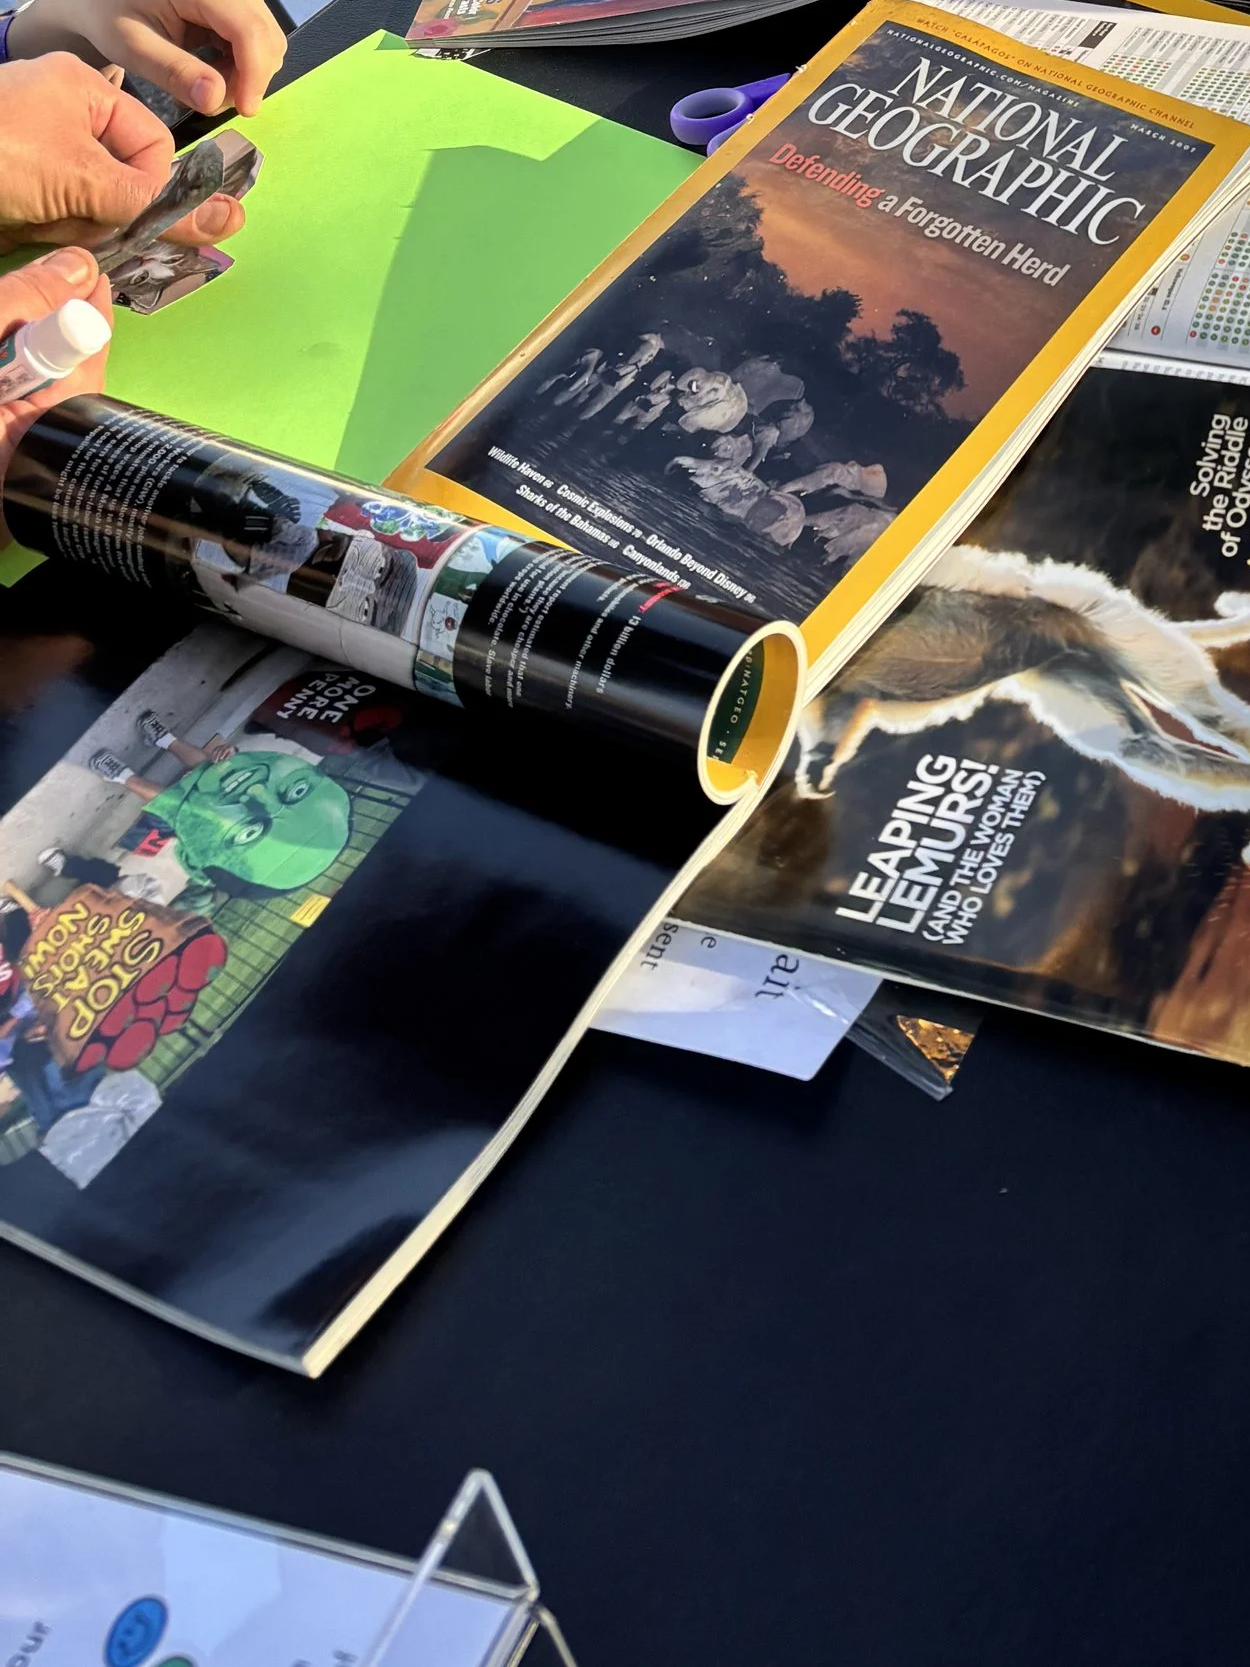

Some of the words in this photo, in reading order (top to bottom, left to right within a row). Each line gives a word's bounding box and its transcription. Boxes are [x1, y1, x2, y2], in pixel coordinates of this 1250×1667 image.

[886, 28, 1081, 108] NATIONALGEOGRAPHIC.COM/MAGAZINE
[915, 18, 951, 34] WATCH
[1016, 56, 1032, 69] ON
[1033, 63, 1083, 88] NATIONAL
[1085, 83, 1148, 113] GEOGRAPHIC
[1148, 106, 1196, 131] CHANNEL
[888, 57, 1129, 183] NATIONAL
[1130, 122, 1166, 142] MARCH
[808, 83, 1146, 246] GEOGRAPHIC
[769, 143, 886, 210] Defending
[877, 192, 900, 212] a
[895, 195, 1007, 259] Forgotten
[1001, 242, 1072, 287] Herd
[71, 422, 105, 461] suppliers
[82, 446, 96, 462] for
[106, 427, 148, 465] awareness
[123, 438, 159, 478] estimates
[150, 444, 183, 478] Workers
[1190, 414, 1232, 498] Solving
[1213, 416, 1249, 489] Riddle
[73, 460, 86, 478] the
[99, 463, 110, 476] of
[106, 451, 132, 484] wages.
[112, 476, 129, 498] that
[155, 462, 179, 490] tackle
[138, 488, 161, 526] another
[487, 446, 521, 471] Wildlife
[516, 461, 546, 487] Haven
[556, 483, 590, 511] Cosmic
[587, 500, 636, 536] Explosions
[645, 533, 684, 561] Orlando
[679, 550, 722, 584] Beyond
[713, 571, 748, 603] Disney
[1202, 492, 1230, 532] the
[515, 484, 547, 511] Sharks
[544, 500, 558, 514] of
[555, 505, 573, 522] the
[569, 513, 612, 545] Bahamas
[622, 543, 680, 584] Canyonlands
[1221, 532, 1241, 558] of
[513, 560, 535, 583] crops
[516, 577, 530, 593] use
[528, 567, 542, 581] for
[485, 579, 517, 627] worldwide.
[510, 591, 520, 602] in
[527, 594, 545, 616] they
[540, 587, 563, 616] report
[488, 600, 514, 649] chocolate.
[519, 613, 545, 660] estimated
[589, 616, 604, 635] and
[608, 624, 634, 657] billion
[483, 649, 496, 674] Slave
[507, 631, 526, 669] cheaper
[577, 632, 594, 660] other
[504, 669, 513, 687] and
[516, 659, 526, 680] that
[563, 659, 581, 710] machinery.
[594, 656, 616, 694] dollars
[275, 671, 340, 722] PENNY
[296, 676, 361, 722] MORE
[319, 682, 378, 724] ONE
[835, 754, 957, 924] LEAPING
[875, 758, 1000, 934] LEMURS!
[922, 890, 962, 942] (AND
[951, 848, 985, 886] THE
[970, 768, 1024, 845] WOMAN
[942, 896, 984, 945] WHO
[970, 832, 1016, 895] LOVES
[1002, 770, 1046, 830] THEM)
[22, 900, 91, 980] NOW!
[50, 909, 146, 1015] SWEAT
[69, 928, 163, 1041] STOP
